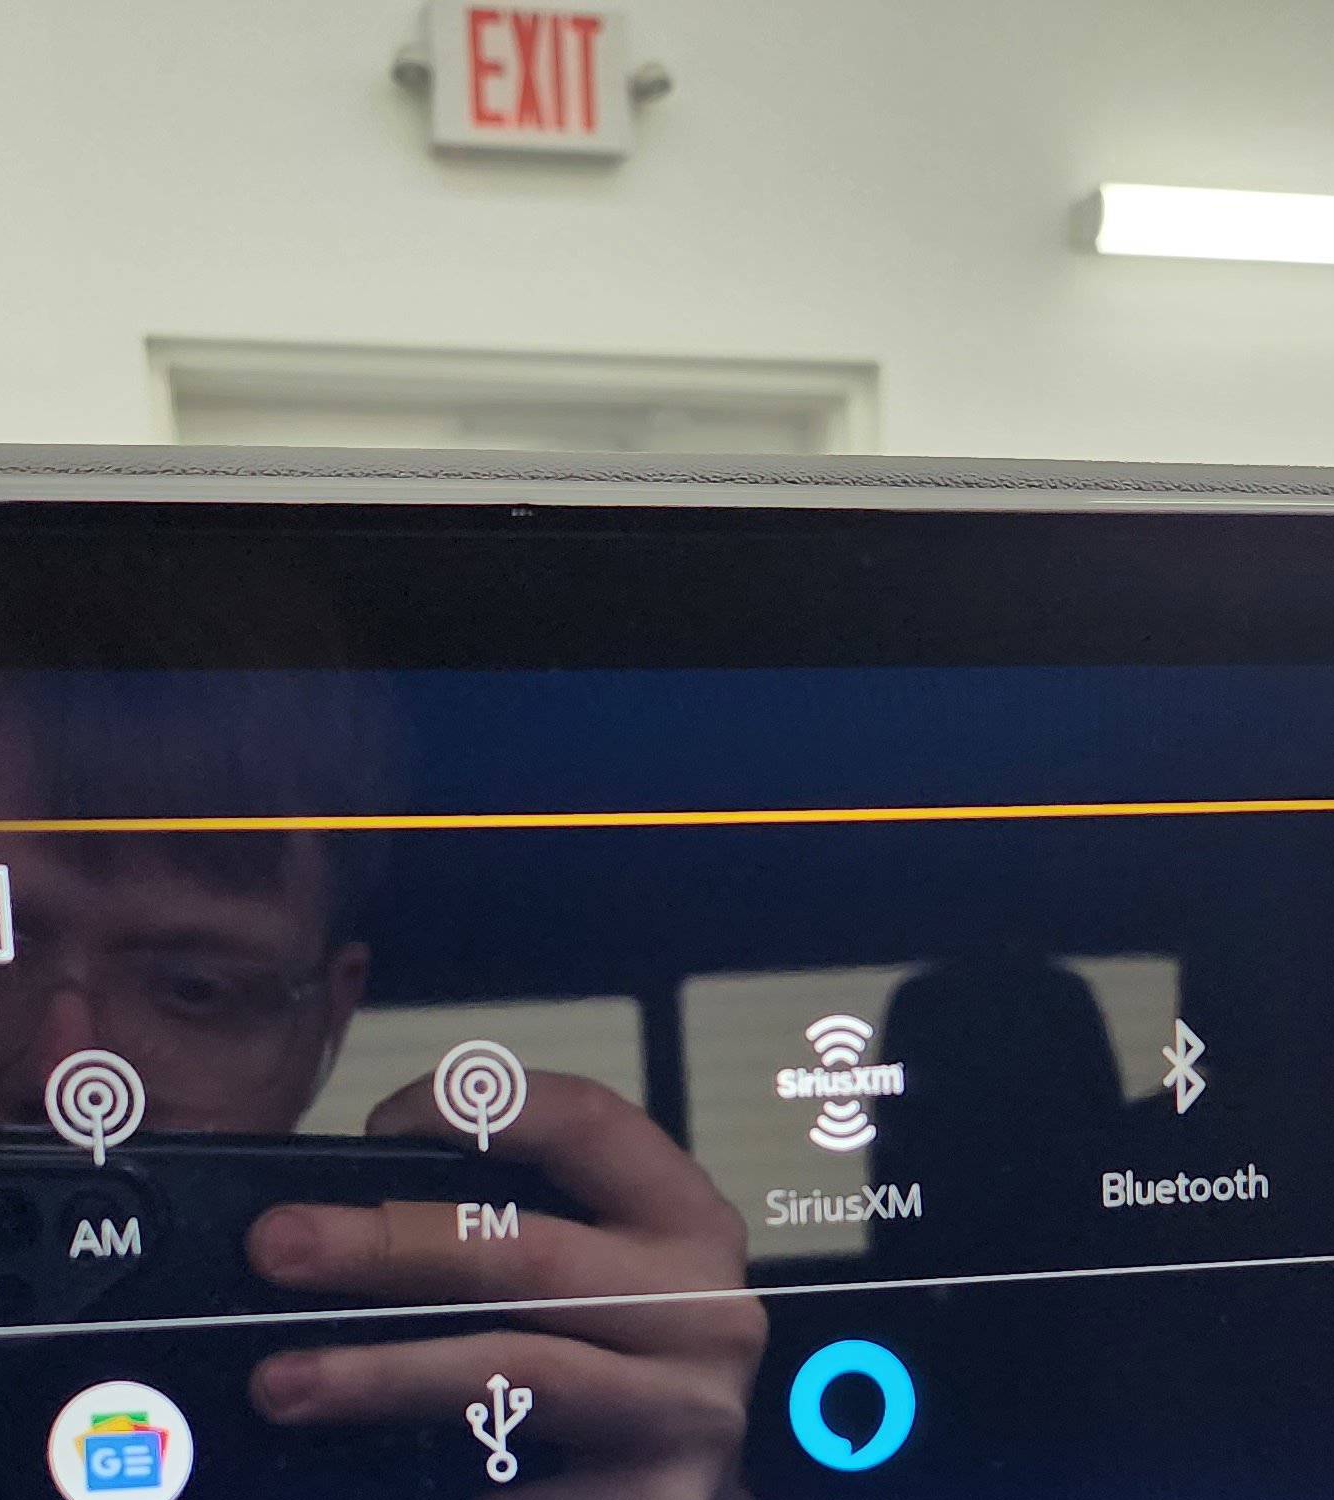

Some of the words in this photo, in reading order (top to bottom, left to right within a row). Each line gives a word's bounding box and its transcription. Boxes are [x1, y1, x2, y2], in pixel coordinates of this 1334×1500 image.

[468, 9, 602, 132] EXIT
[765, 1182, 923, 1226] SiriusXM
[1103, 1164, 1268, 1207] Bluetooth
[70, 1217, 141, 1258] AM
[457, 1202, 519, 1240] FM
